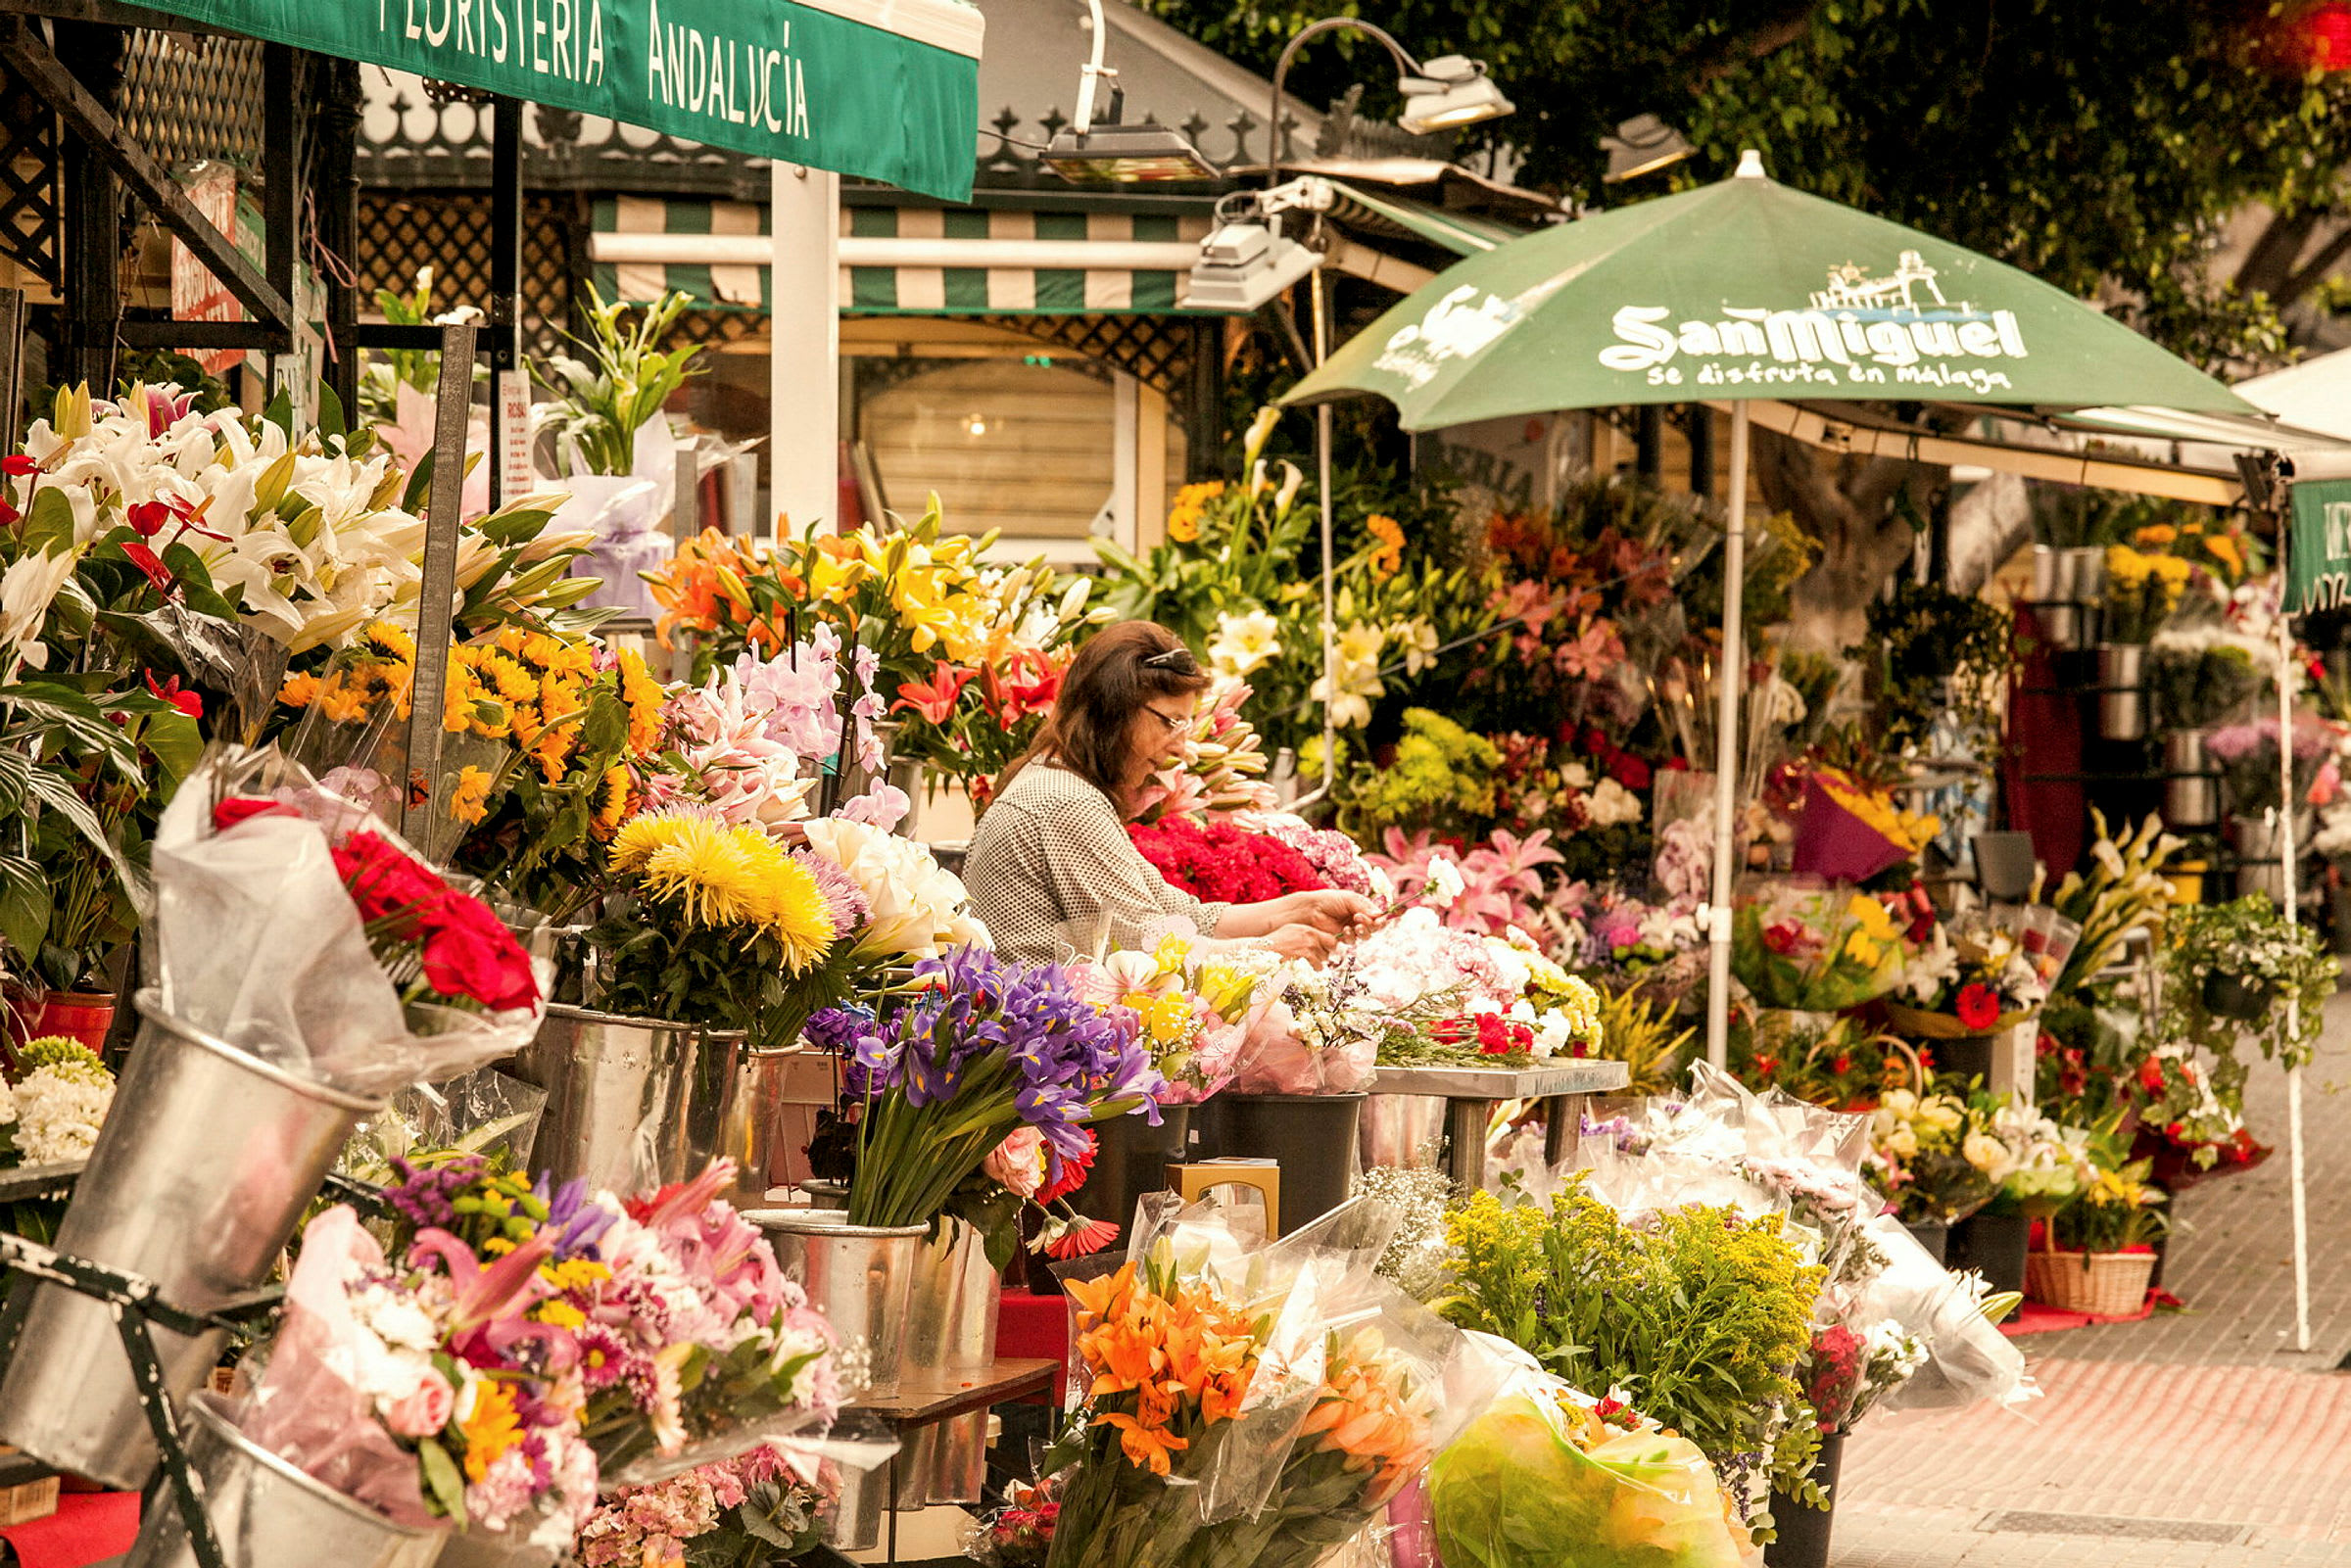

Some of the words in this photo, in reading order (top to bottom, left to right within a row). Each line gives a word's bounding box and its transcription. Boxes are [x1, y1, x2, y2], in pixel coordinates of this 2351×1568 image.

[648, 0, 810, 139] ANDALUCÍA
[1647, 365, 1684, 386] se
[1697, 360, 1839, 386] disfruta
